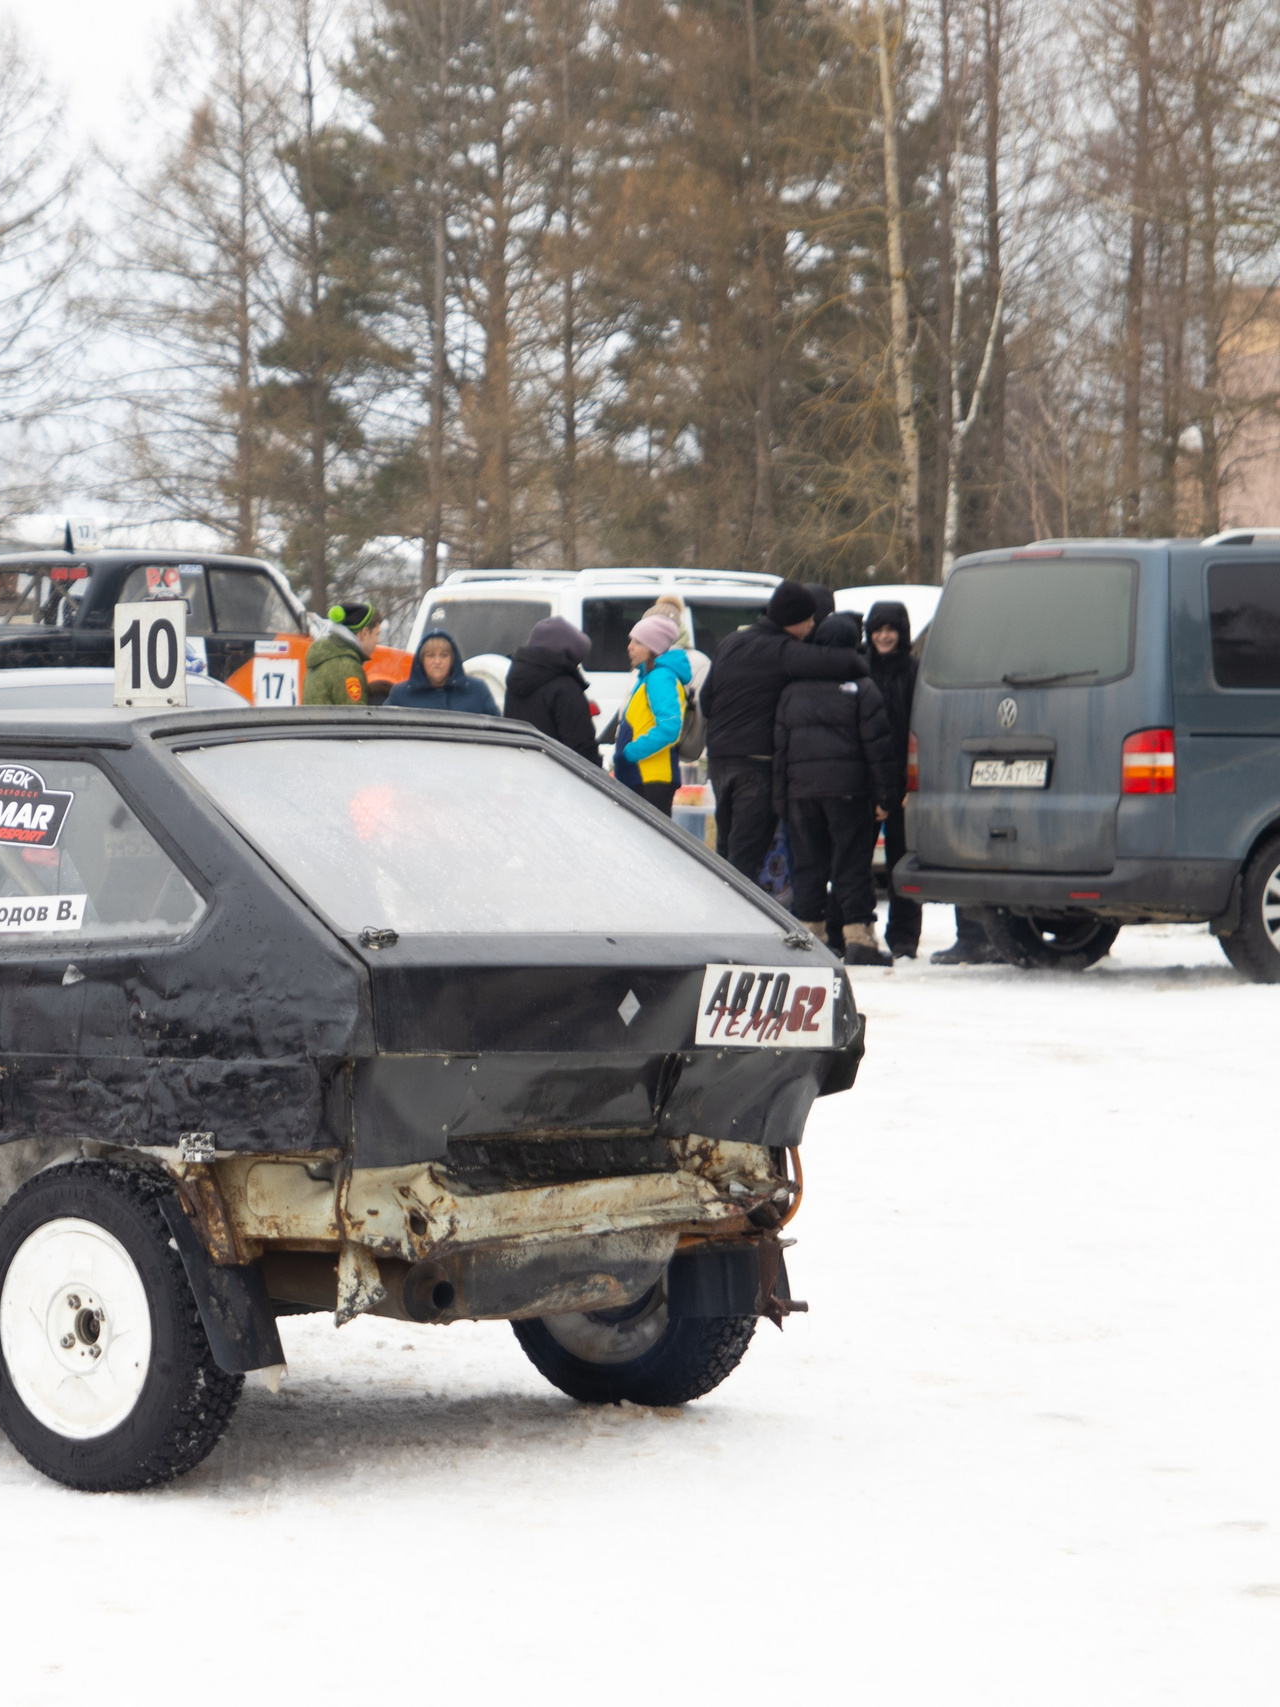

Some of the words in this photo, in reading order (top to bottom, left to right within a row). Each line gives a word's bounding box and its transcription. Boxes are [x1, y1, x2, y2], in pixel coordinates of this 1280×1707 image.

[120, 618, 178, 690] 10
[262, 672, 286, 700] 17
[56, 900, 78, 921] В.
[704, 970, 791, 1019] АВТО
[709, 1005, 790, 1043] ТЕМА
[785, 985, 827, 1032] 62
